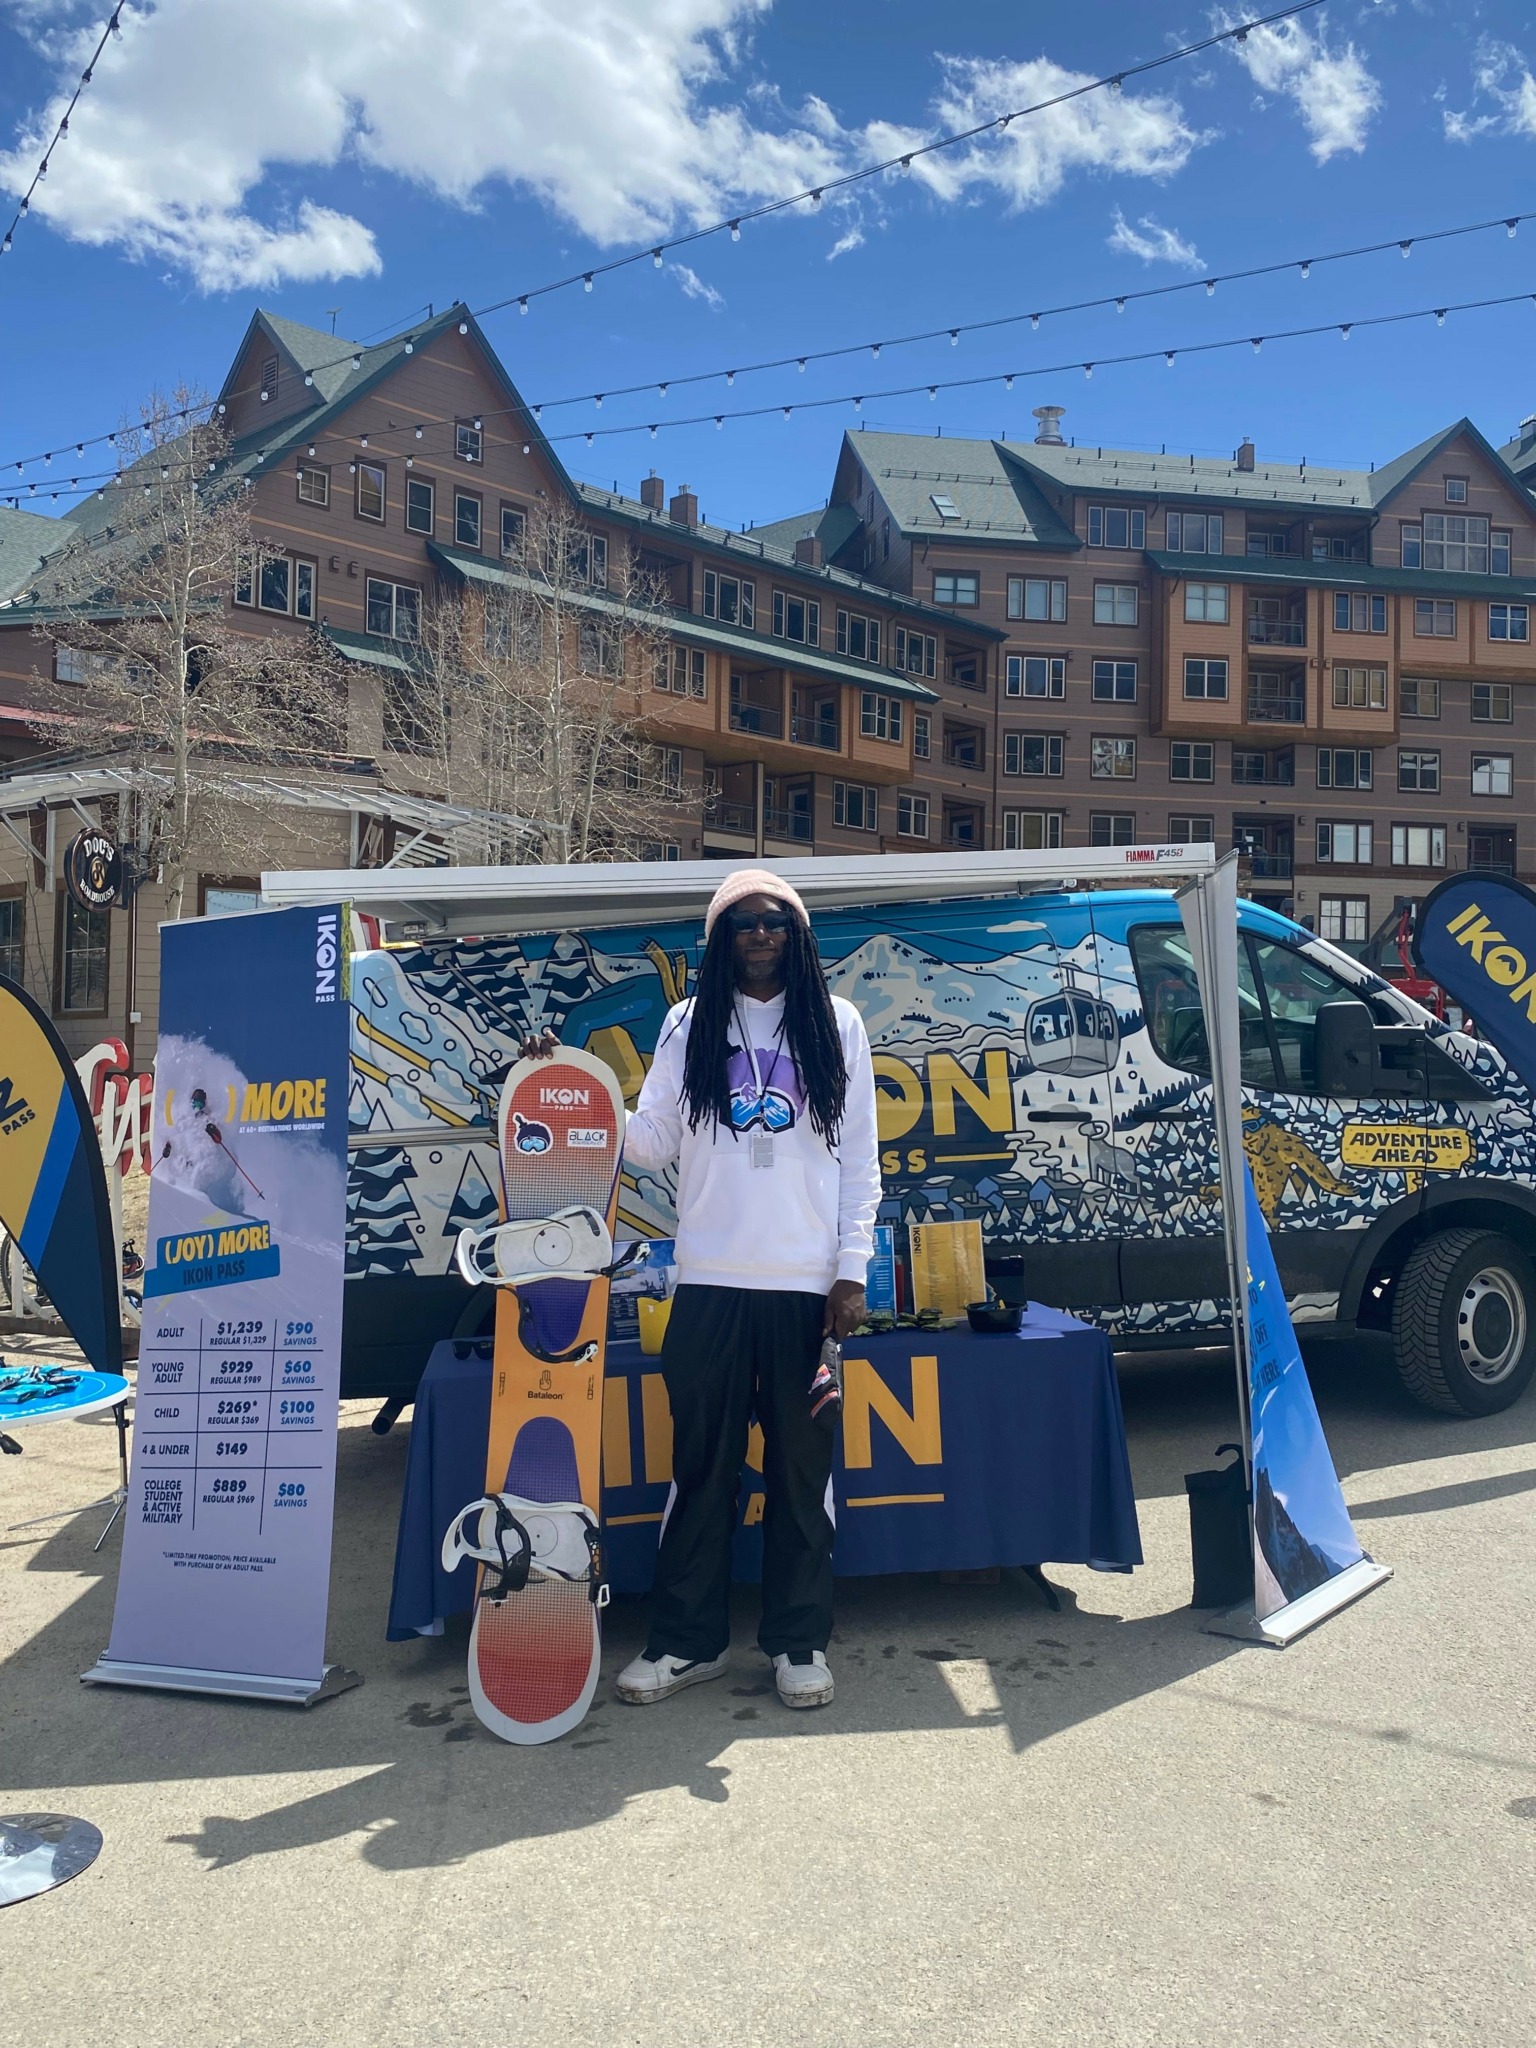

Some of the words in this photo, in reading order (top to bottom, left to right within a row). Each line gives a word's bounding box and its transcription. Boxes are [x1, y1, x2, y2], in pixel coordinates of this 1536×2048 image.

[83, 837, 115, 861] DOC'S
[1125, 850, 1155, 862] FIAMMA
[80, 879, 115, 903] ROADHOUSE
[316, 914, 337, 994] IKON
[315, 995, 336, 1003] PASS
[240, 1078, 327, 1122] MORE
[540, 1087, 590, 1105] IKON
[871, 1050, 1014, 1142] ON
[2, 1109, 36, 1136] PASS
[258, 1124, 292, 1133] DESTINATIONS
[293, 1122, 325, 1131] WORLDWIDE
[569, 1130, 605, 1142] BLACK
[1349, 1132, 1463, 1150] ADVENTURE
[881, 1148, 927, 1175] SS
[1371, 1148, 1438, 1163] AHEAD
[165, 1233, 214, 1265] (JOY)
[217, 1224, 270, 1257] MORE
[913, 1227, 922, 1252] IKON
[183, 1264, 213, 1286] IKON
[217, 1259, 245, 1280] PASS
[156, 1327, 185, 1338] ADULT
[217, 1320, 263, 1336] $1,239
[286, 1321, 314, 1336] $90
[210, 1337, 241, 1346] REGULAR
[242, 1335, 267, 1345] $1,329
[283, 1337, 317, 1346] SAVINGS
[151, 1362, 185, 1373] YOUNG
[220, 1360, 254, 1375] $929
[284, 1360, 312, 1375] $60
[154, 1372, 183, 1383] ADULT
[210, 1376, 242, 1385] REGULAR
[243, 1375, 262, 1385] $989
[281, 1375, 316, 1385] SAVINGS
[527, 1390, 563, 1400] Bataleon
[154, 1407, 180, 1419] CHILD
[280, 1400, 315, 1415] $100
[207, 1416, 239, 1425] REGULAR
[241, 1415, 260, 1426] $369
[280, 1416, 315, 1425] SAVINGS
[142, 1444, 148, 1455] 4
[149, 1444, 156, 1455] &
[158, 1444, 190, 1455] UNDER
[216, 1441, 248, 1456] $149
[144, 1480, 182, 1490] COLLEGE
[213, 1478, 247, 1493] $889
[278, 1482, 306, 1497] $80
[144, 1490, 183, 1501] STUDENT
[202, 1495, 235, 1503] REGULAR
[236, 1494, 256, 1504] $969
[142, 1501, 149, 1512] &
[151, 1502, 182, 1513] ACTIVE
[273, 1499, 308, 1508] SAVINGS
[142, 1512, 183, 1524] MILITARY
[173, 1560, 187, 1568] WITH
[187, 1561, 214, 1570] PURCHASE
[214, 1562, 223, 1570] OF
[223, 1563, 232, 1571] AN
[232, 1564, 250, 1572] ADULT
[232, 1555, 248, 1563] PRICE
[248, 1556, 277, 1565] AVAILABLE
